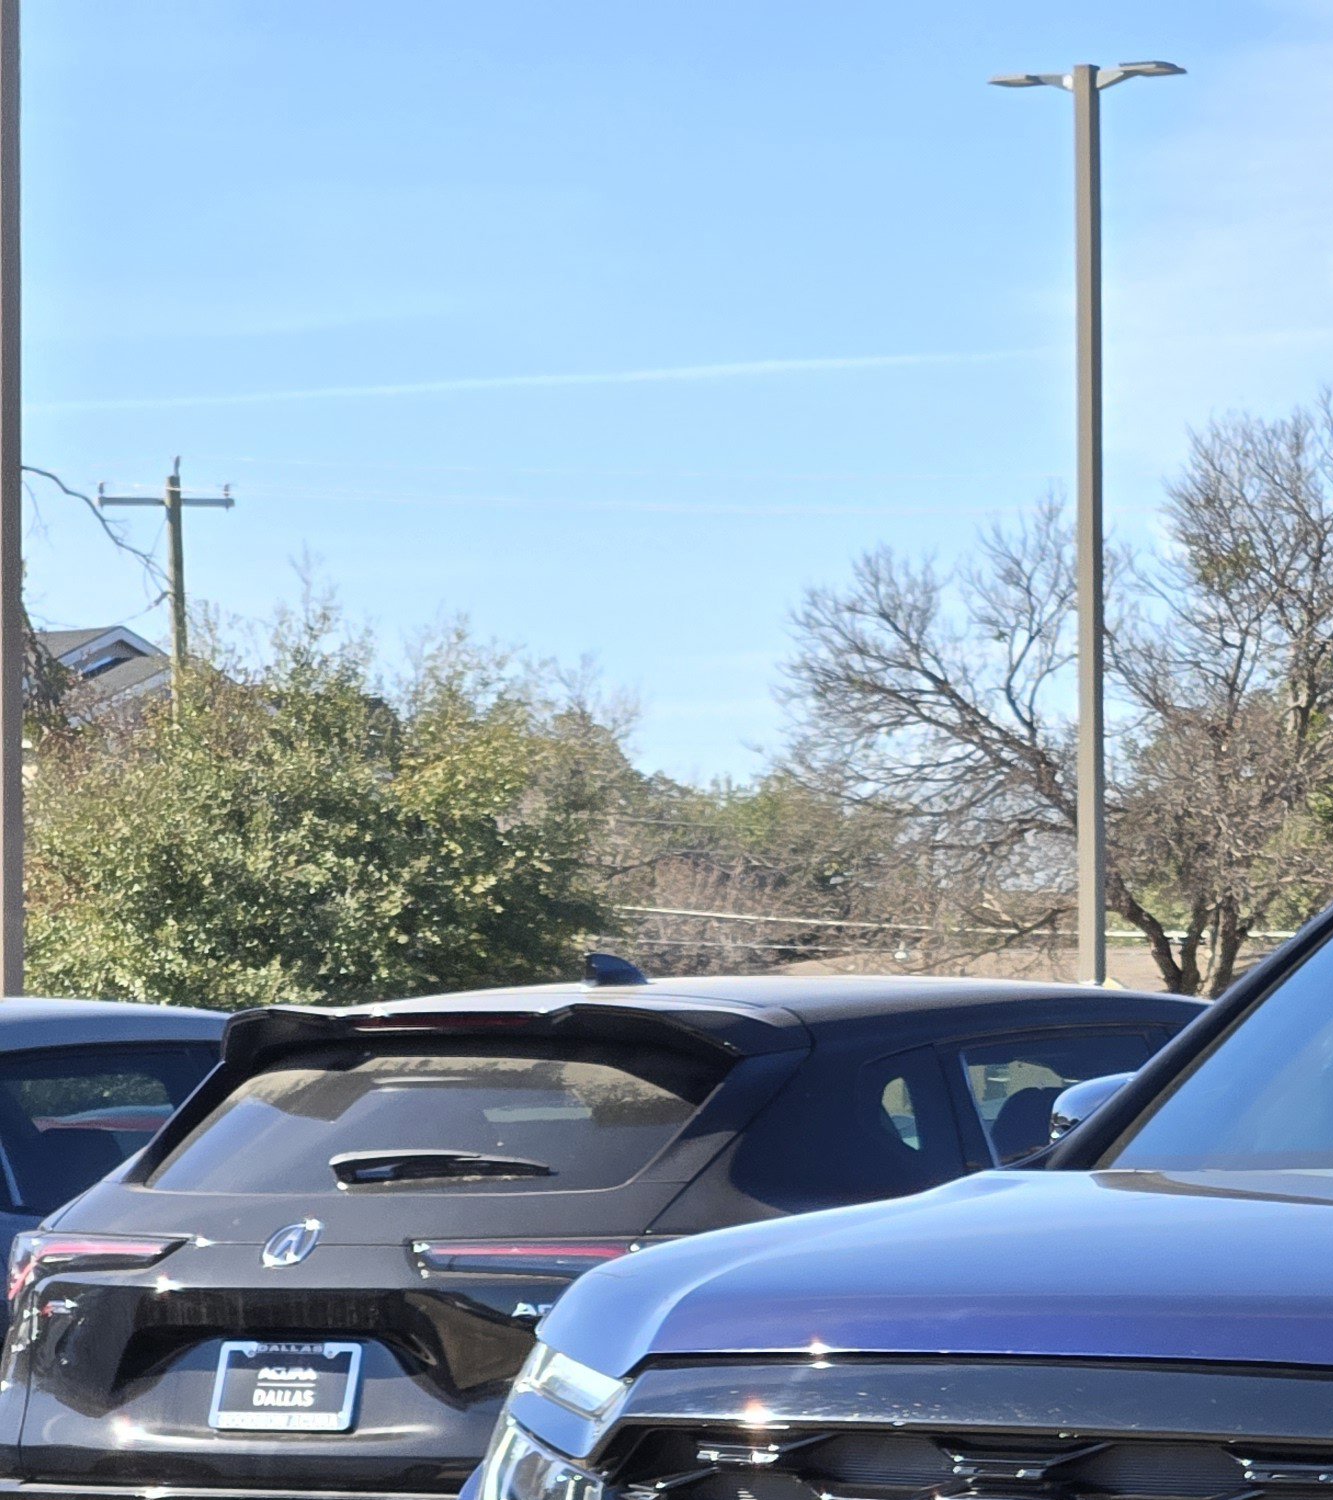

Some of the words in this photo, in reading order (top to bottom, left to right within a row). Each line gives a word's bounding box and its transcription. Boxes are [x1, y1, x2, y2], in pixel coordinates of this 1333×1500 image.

[257, 1343, 323, 1353] DALLAS
[257, 1366, 318, 1380] ACURA
[252, 1388, 315, 1407] DALLAS
